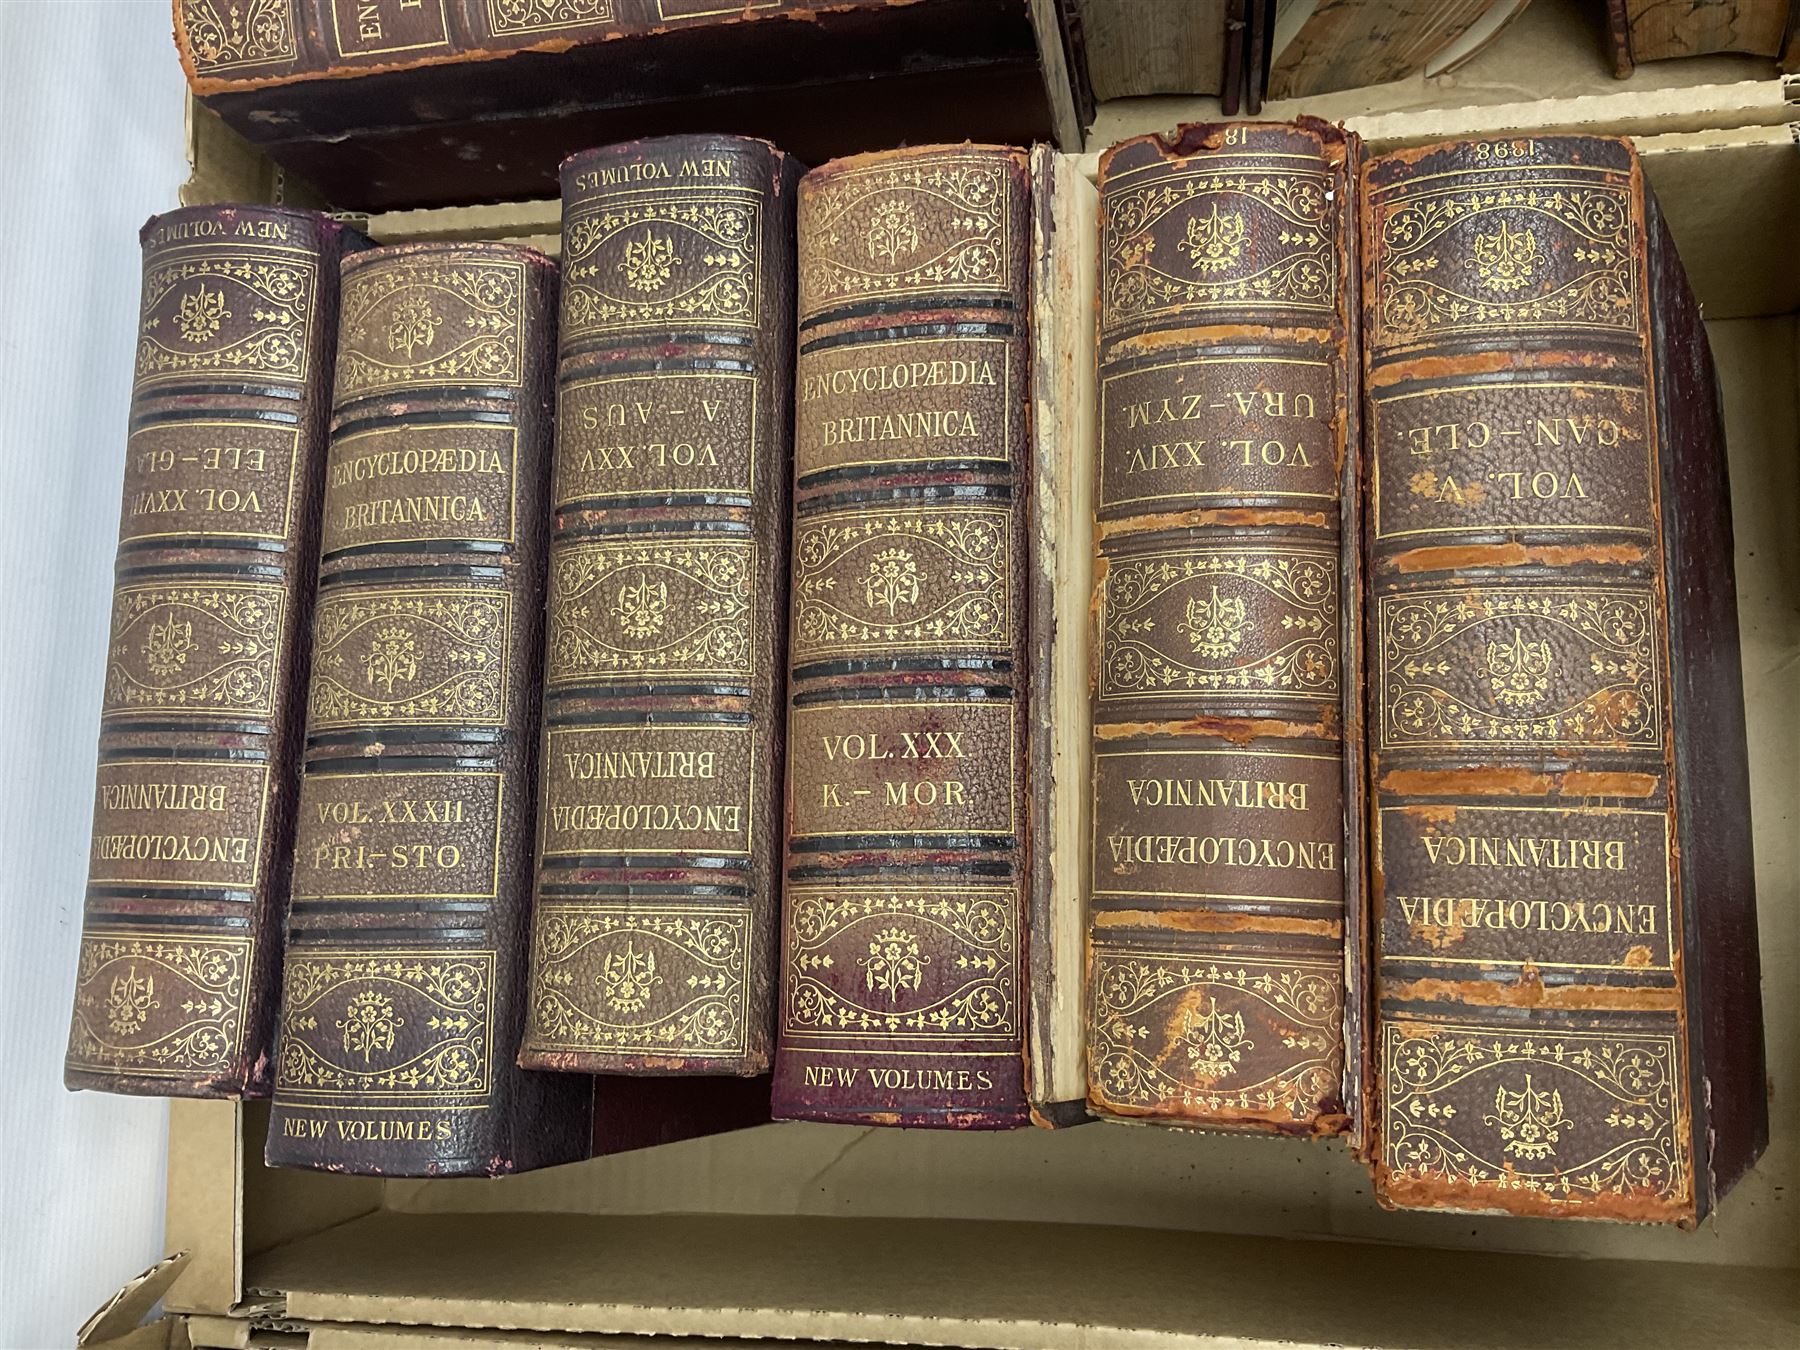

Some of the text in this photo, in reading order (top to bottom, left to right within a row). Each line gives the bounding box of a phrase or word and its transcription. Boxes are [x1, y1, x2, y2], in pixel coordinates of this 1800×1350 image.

[357, 0, 382, 42] EN
[575, 159, 732, 192] NEW VOLUMES
[150, 220, 288, 249] NEW VOLUMES
[803, 361, 997, 402] ENCYCLOPÆDIA
[583, 401, 653, 430] AUS
[822, 410, 979, 447] BRITANNICA
[332, 449, 506, 489] ENCYCLOPÆDIA
[580, 443, 720, 472] VOL. XXV
[1126, 440, 1313, 474] VOL. XXIV.
[195, 488, 263, 512] VOL.
[1434, 471, 1589, 503] VOL. V.
[343, 495, 488, 531] BRITANNICA
[823, 731, 974, 761] VOL. XXX.
[564, 751, 716, 779] BRITANNICA
[102, 783, 228, 811] BRITANNICA
[1126, 779, 1310, 811] BRITANNICA
[316, 799, 471, 825] VOL. XXXII.
[551, 804, 742, 833] ENCYCLOPÆDIA
[1107, 835, 1338, 870] ENCYCLOPÆDIA
[1420, 836, 1627, 870] BRITANNICA
[1396, 896, 1658, 935] ENCYCLOPÆDIA
[803, 1066, 994, 1091] NEW VOLUMES
[282, 1117, 453, 1142] NEW VOLUMES
